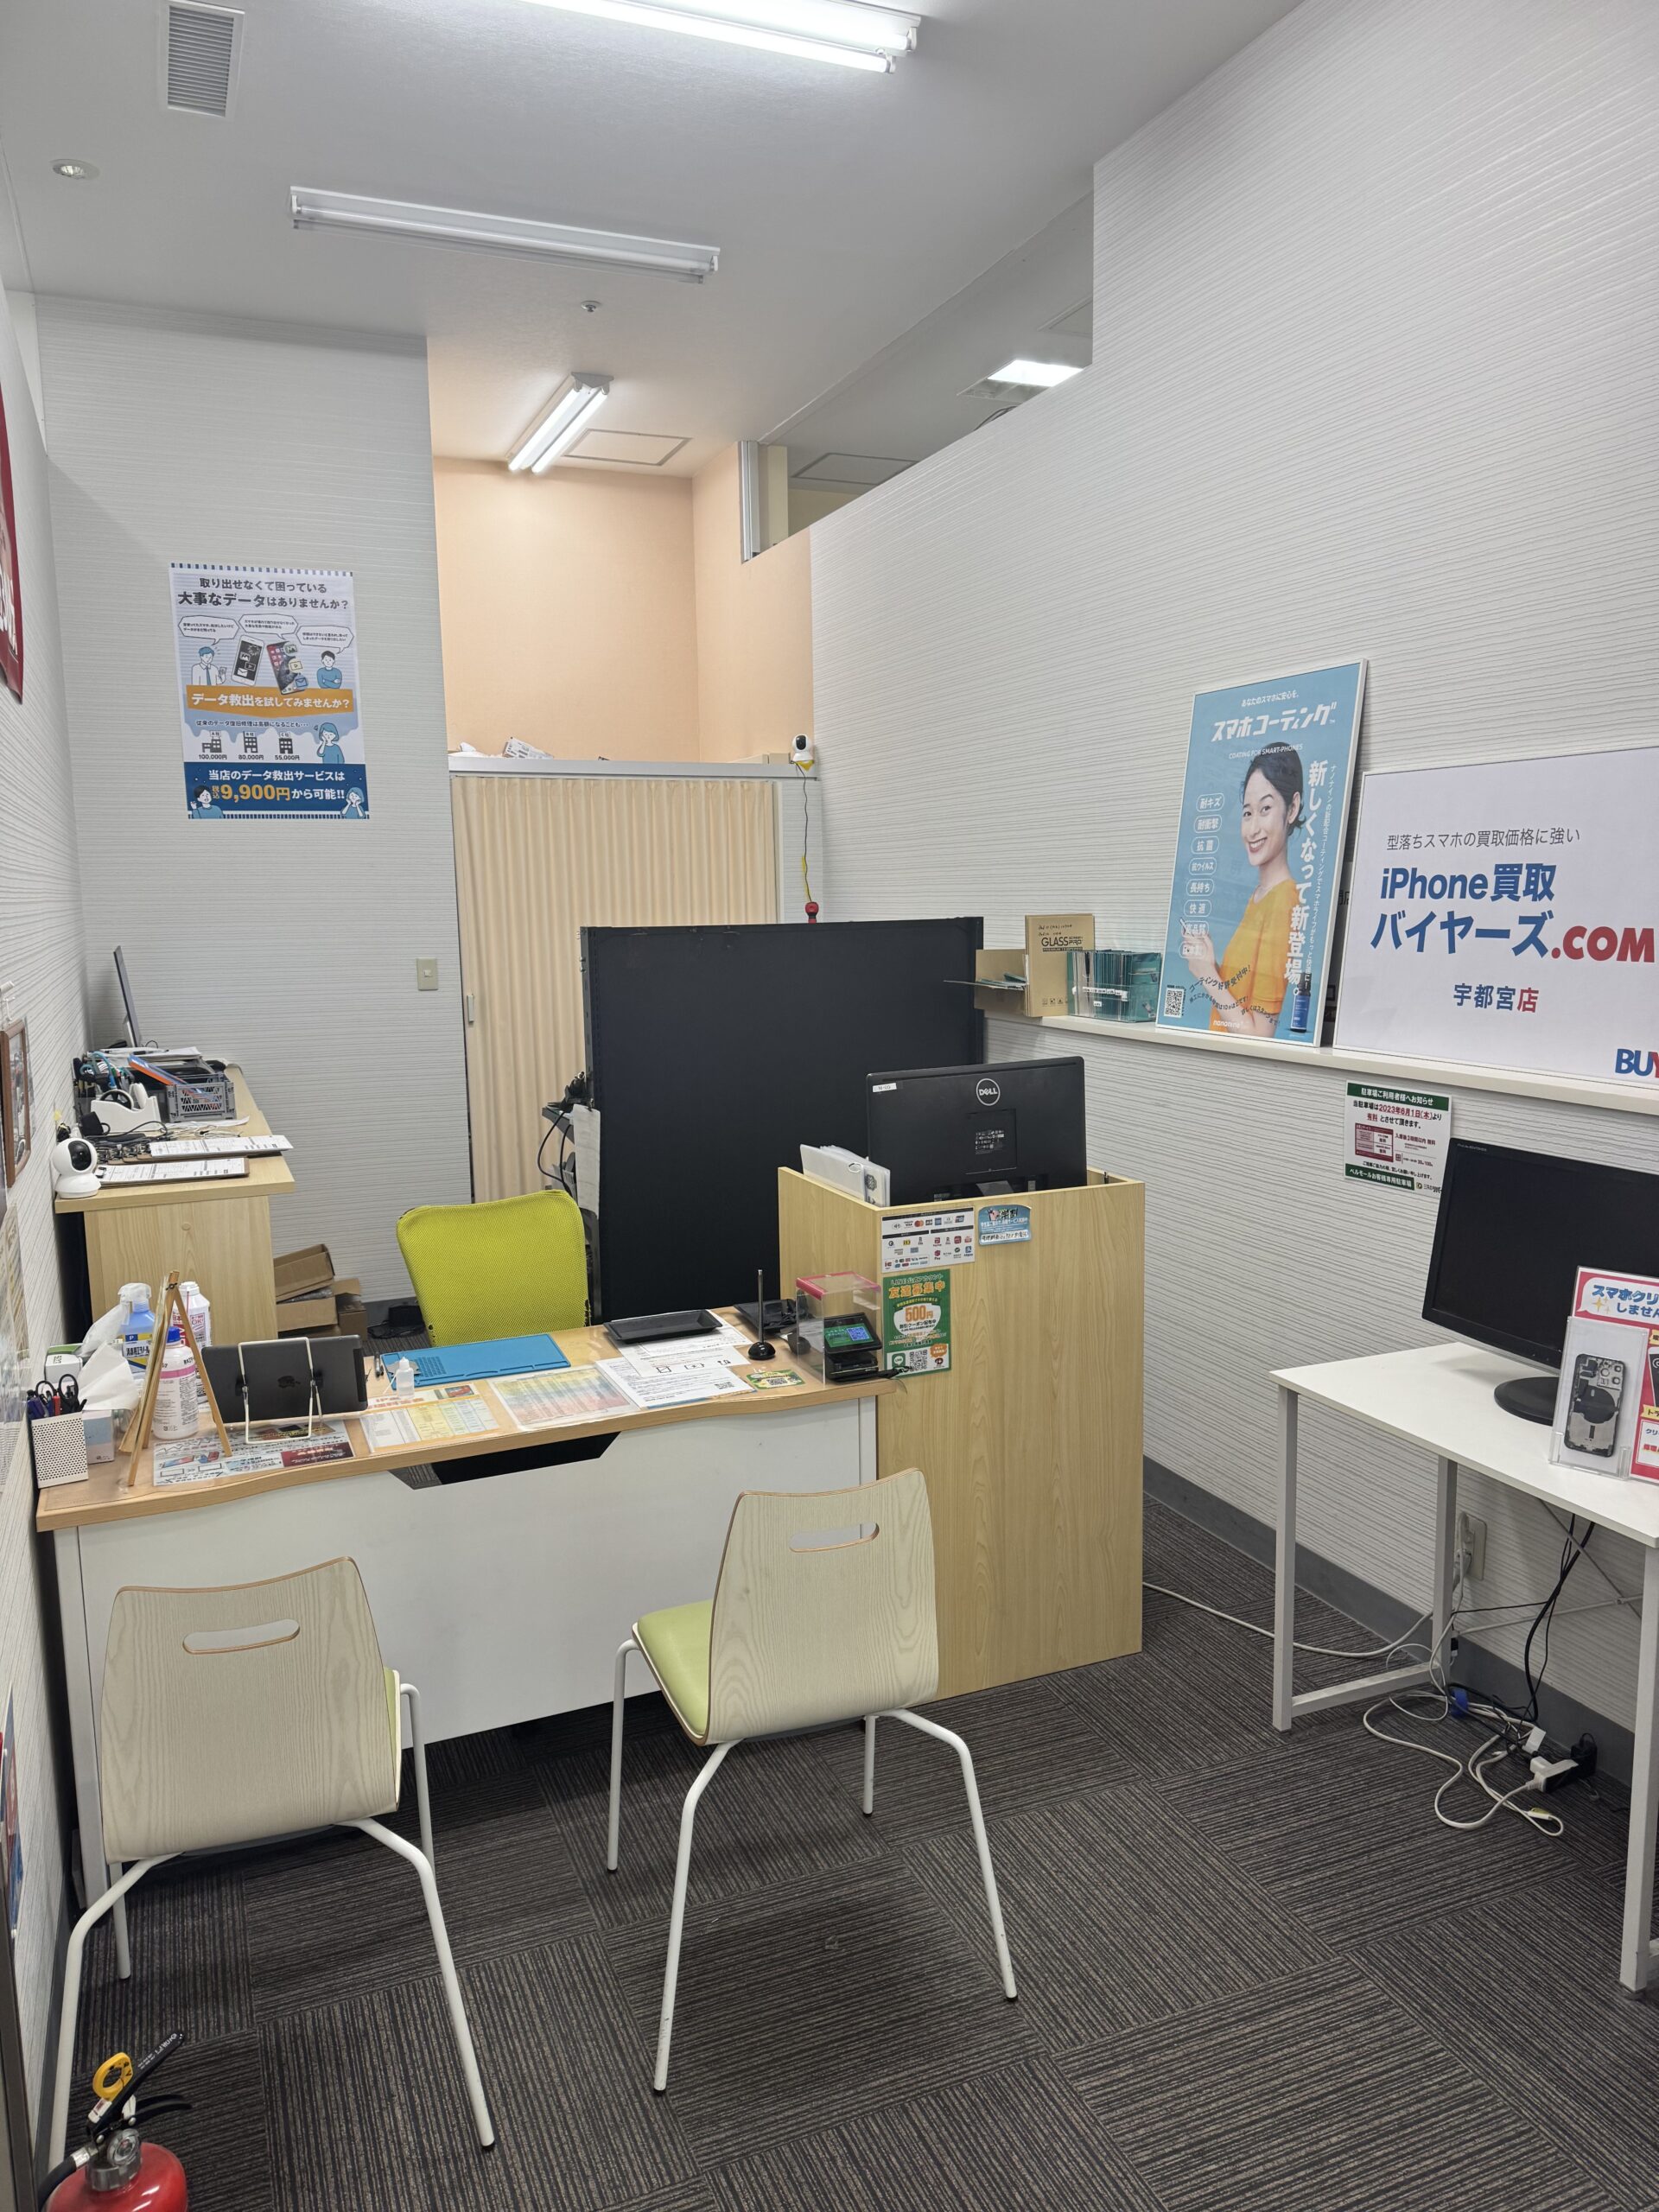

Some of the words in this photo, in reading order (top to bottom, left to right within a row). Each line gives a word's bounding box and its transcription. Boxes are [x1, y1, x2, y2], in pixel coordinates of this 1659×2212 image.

[199, 577, 327, 594] 取り出せなくて困っている
[1241, 690, 1300, 708] あなたのスマホに安心を。
[1211, 702, 1338, 742] スマホコーティング
[1229, 749, 1251, 760] COATING
[1262, 744, 1304, 757] SMART-PHONES
[208, 769, 346, 782] 当店のデータ救出サービスは
[1199, 796, 1222, 810] 耐キズ
[1198, 817, 1219, 831] 耐衝撃
[1196, 839, 1215, 853] 抗菌
[1386, 827, 1581, 851] 型落ちスマホの買取価格に強い
[1192, 861, 1215, 873] 抗ウイルス
[1189, 880, 1211, 894] 長持ち
[1381, 863, 1557, 902] iPhone買取
[1189, 901, 1207, 915] 快適
[1041, 936, 1069, 947] GLASS
[1453, 982, 1540, 1014] 宇都宮店
[978, 1087, 998, 1096] DELL
[905, 1306, 934, 1322] 500円
